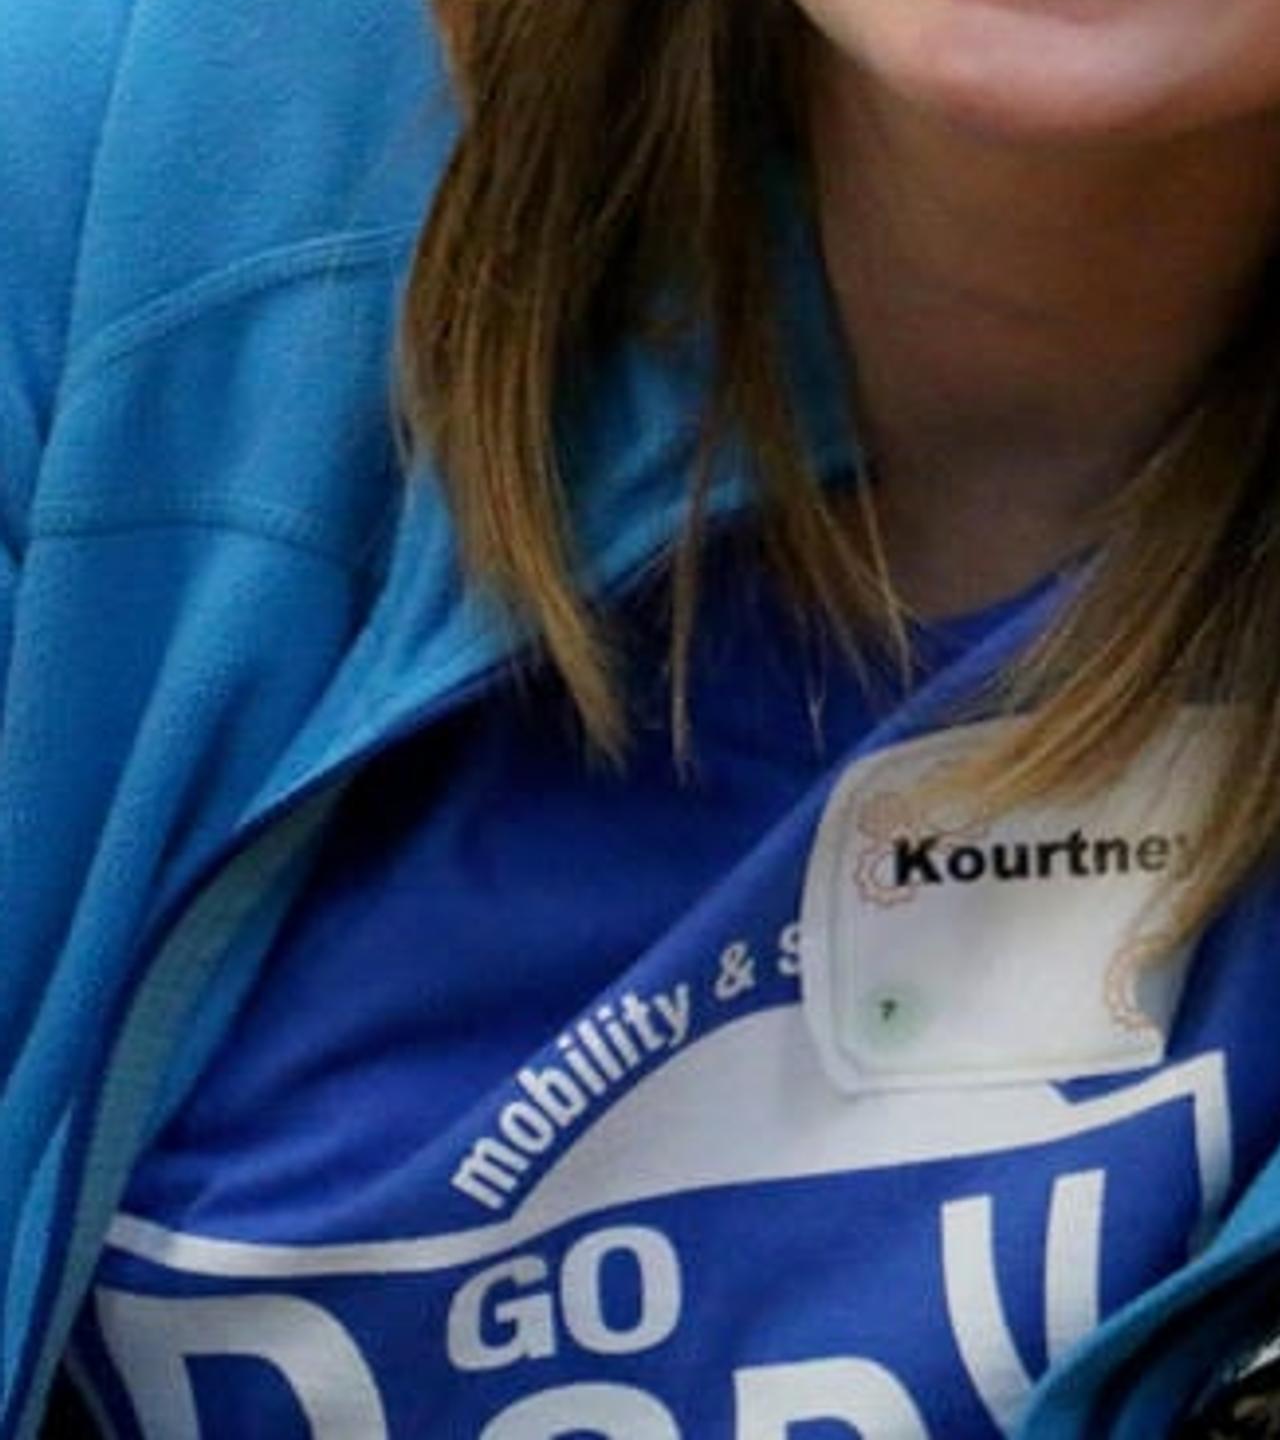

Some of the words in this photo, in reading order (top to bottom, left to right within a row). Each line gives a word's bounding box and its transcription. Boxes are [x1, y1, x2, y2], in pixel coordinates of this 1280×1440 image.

[450, 982, 691, 1210] mobility
[714, 940, 758, 1000] &
[446, 1224, 682, 1373] GO
